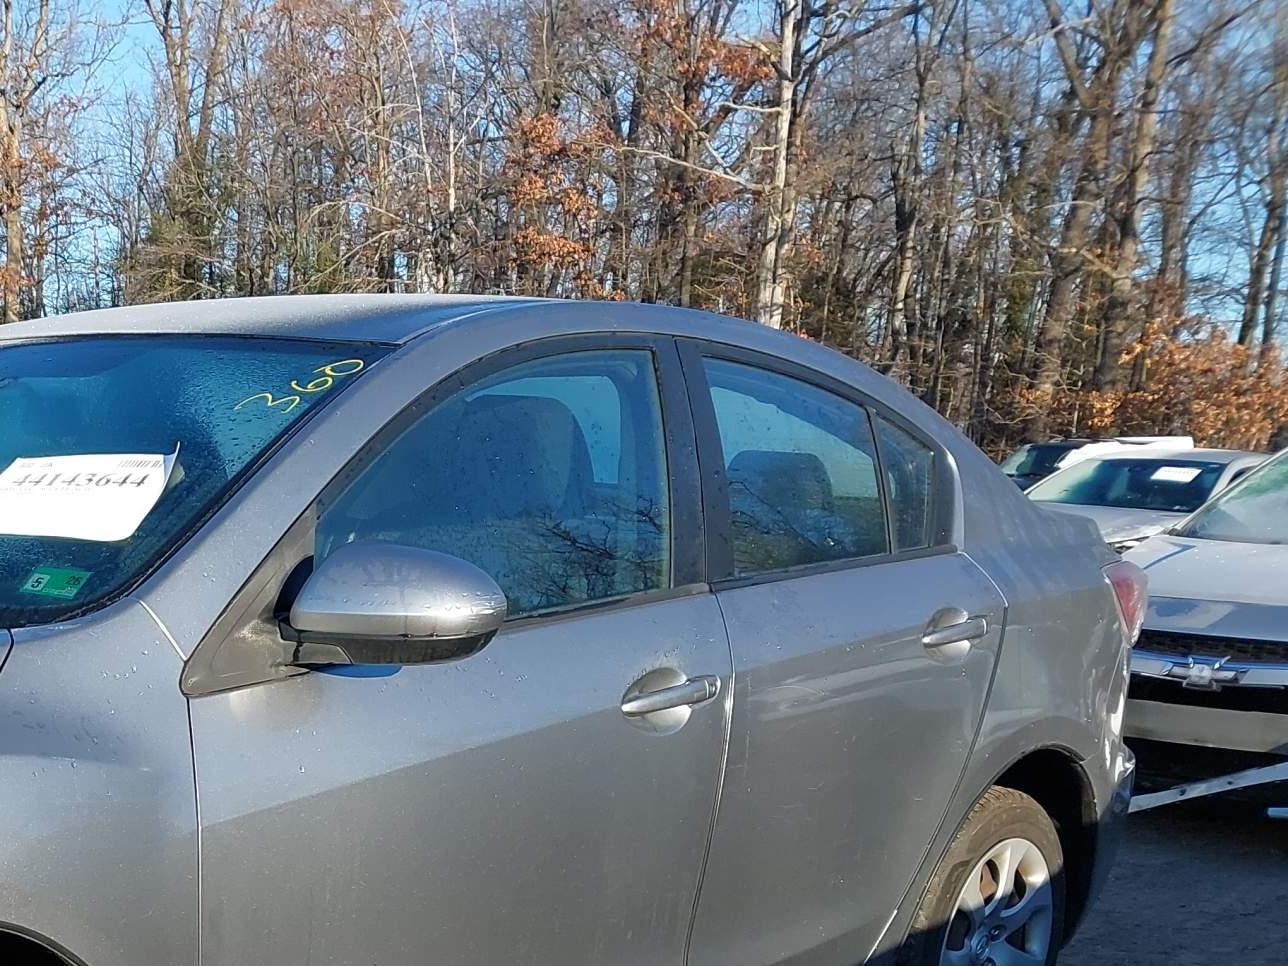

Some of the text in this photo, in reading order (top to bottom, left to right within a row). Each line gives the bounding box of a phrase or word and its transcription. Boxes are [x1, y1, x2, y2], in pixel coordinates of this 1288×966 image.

[233, 359, 364, 413] 360
[12, 472, 150, 488] 44143644
[30, 576, 45, 589] 5
